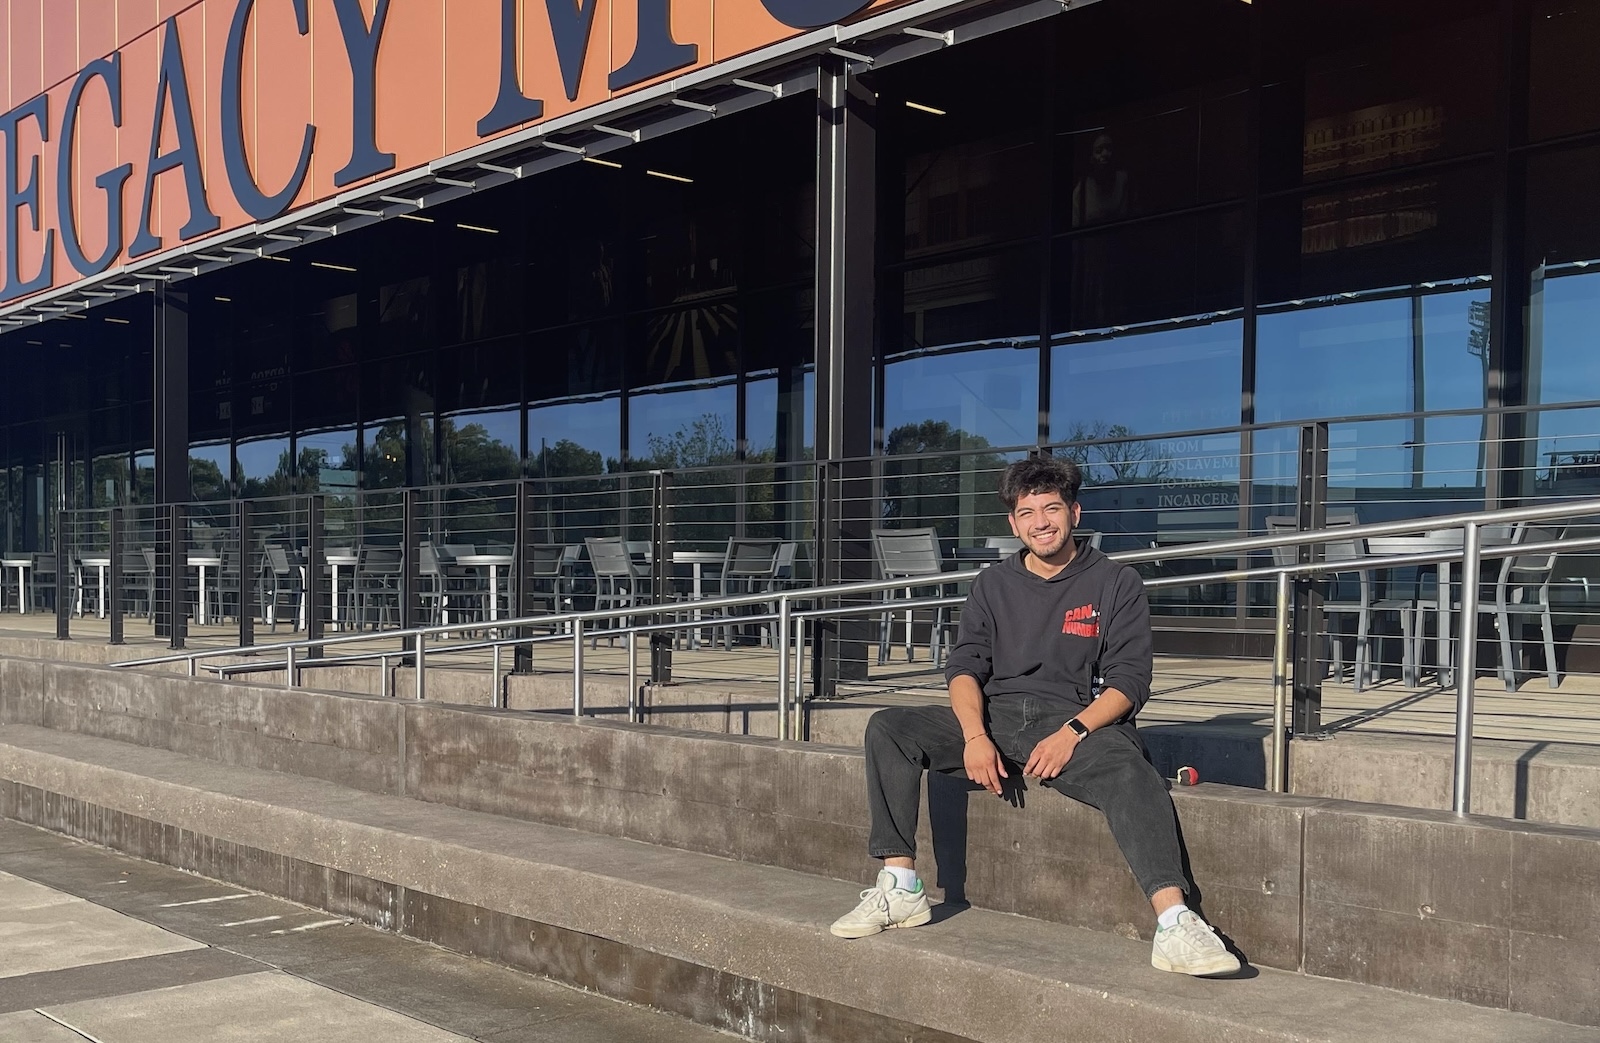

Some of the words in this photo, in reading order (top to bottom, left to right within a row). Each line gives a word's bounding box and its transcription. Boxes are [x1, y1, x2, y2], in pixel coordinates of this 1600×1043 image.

[0, 0, 396, 303] EGACY
[1160, 440, 1199, 455] FROM
[1159, 478, 1177, 490] TO
[1181, 475, 1219, 489] MASS
[1157, 492, 1240, 508] INCARCERA
[1065, 603, 1093, 622] CAN
